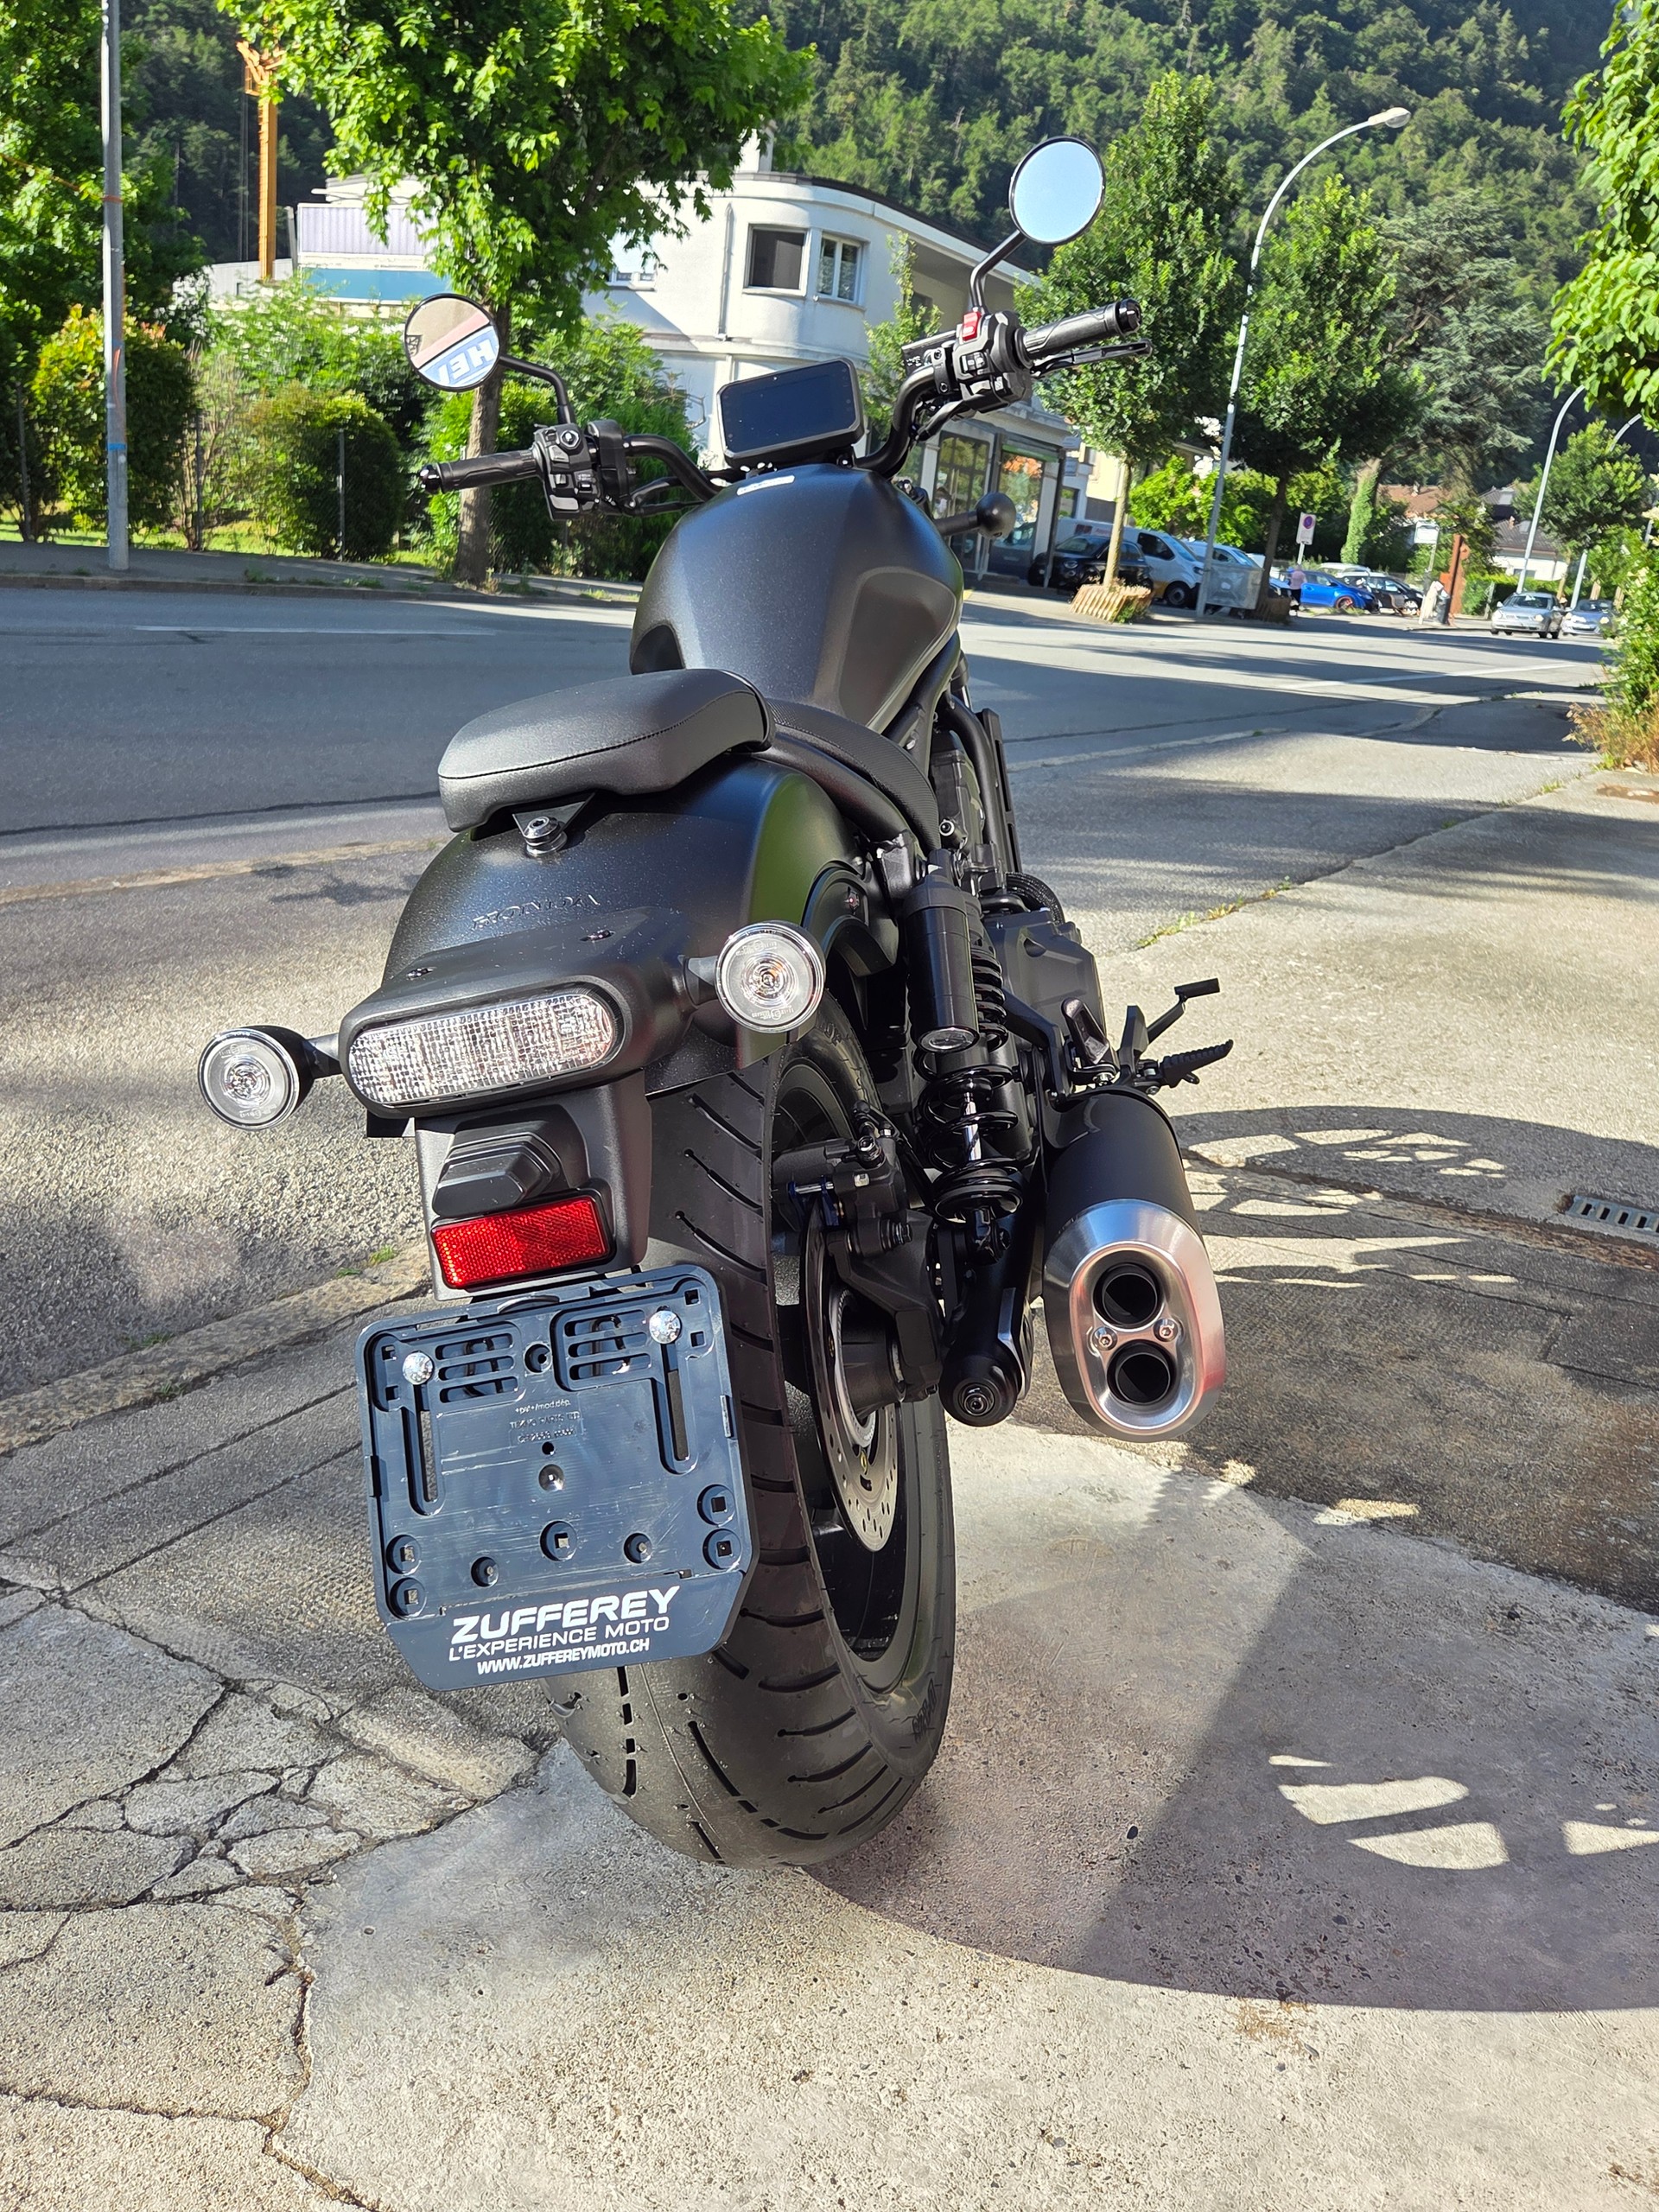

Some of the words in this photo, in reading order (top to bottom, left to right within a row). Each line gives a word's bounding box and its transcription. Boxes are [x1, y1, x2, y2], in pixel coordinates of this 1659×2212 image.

[451, 1585, 681, 1645] ZUFFEREY
[448, 1628, 597, 1662] L'EXPERIENCE
[605, 1616, 670, 1639] MOTO
[476, 1637, 650, 1675] WWW.ZUFFEREYMOTO.CH
